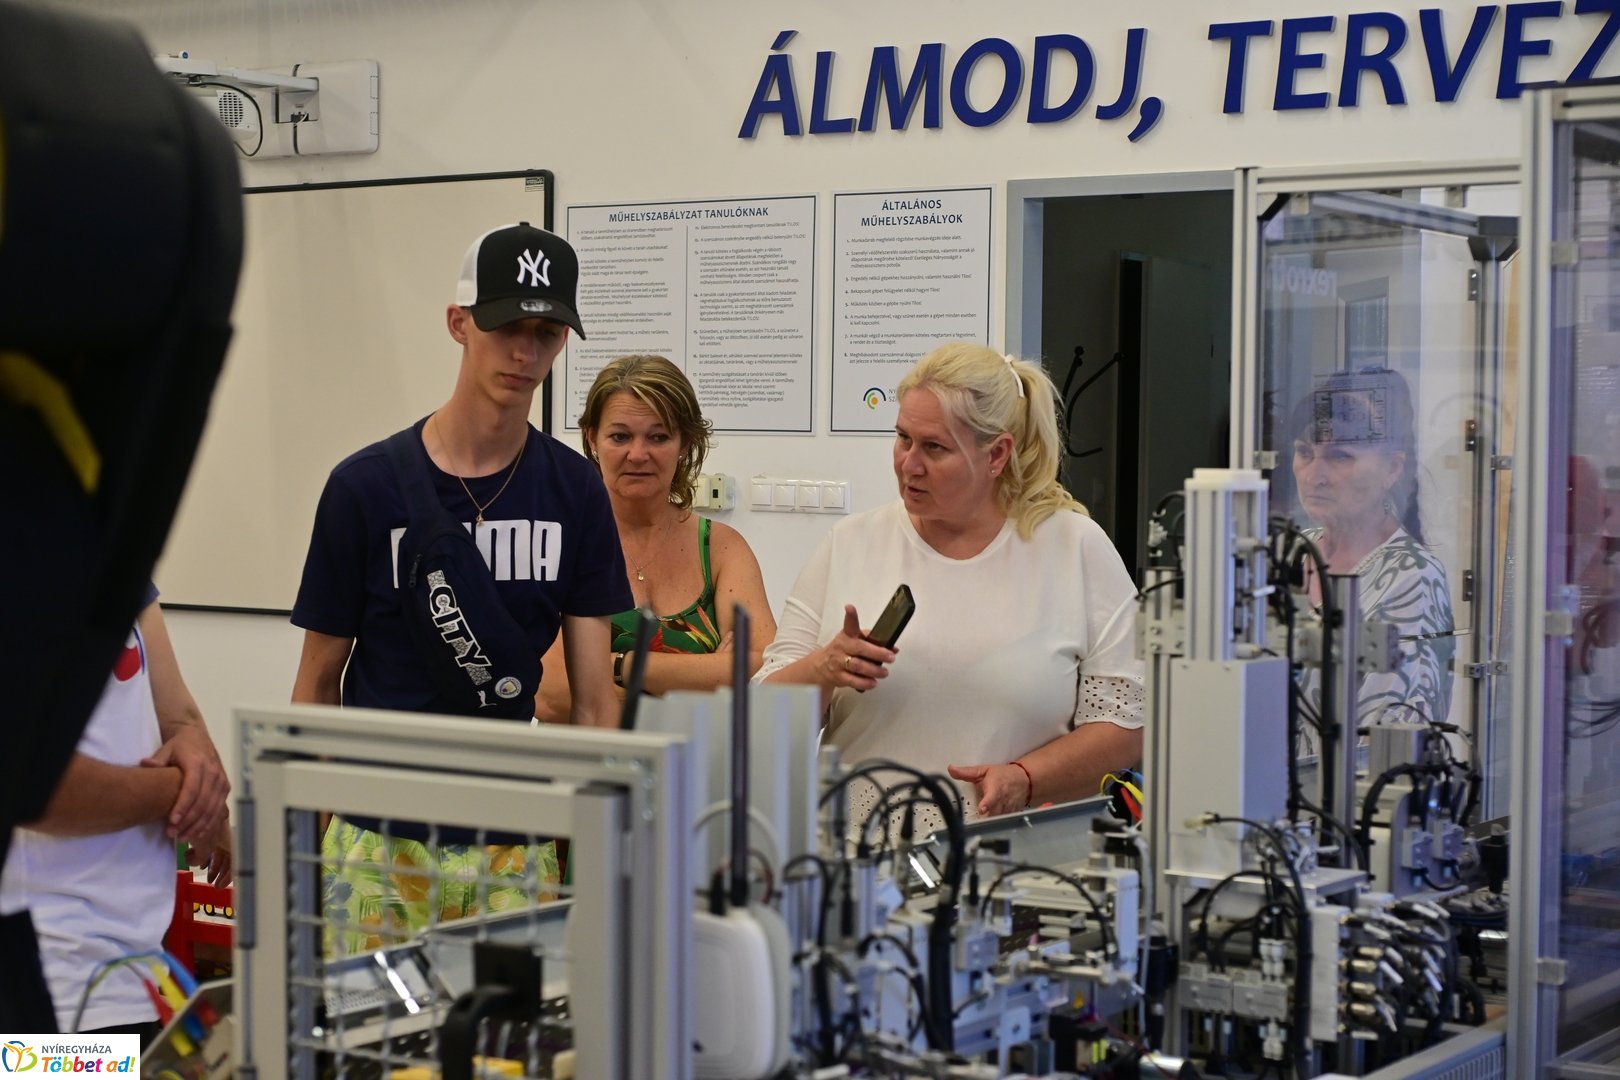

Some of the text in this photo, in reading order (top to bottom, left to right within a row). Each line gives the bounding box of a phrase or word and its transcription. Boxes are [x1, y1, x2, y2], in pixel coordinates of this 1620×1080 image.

[738, 30, 1165, 142] ÁLMODJ,
[609, 206, 768, 222] MŰHELYSZABÁLYZAT TANULÓKNAK
[860, 213, 963, 226] MŰHELYSZABÁLYOK
[882, 198, 942, 210] ÁLTALÁNOS
[516, 248, 551, 287] NY
[390, 519, 562, 588] MA
[430, 584, 492, 667] CITY
